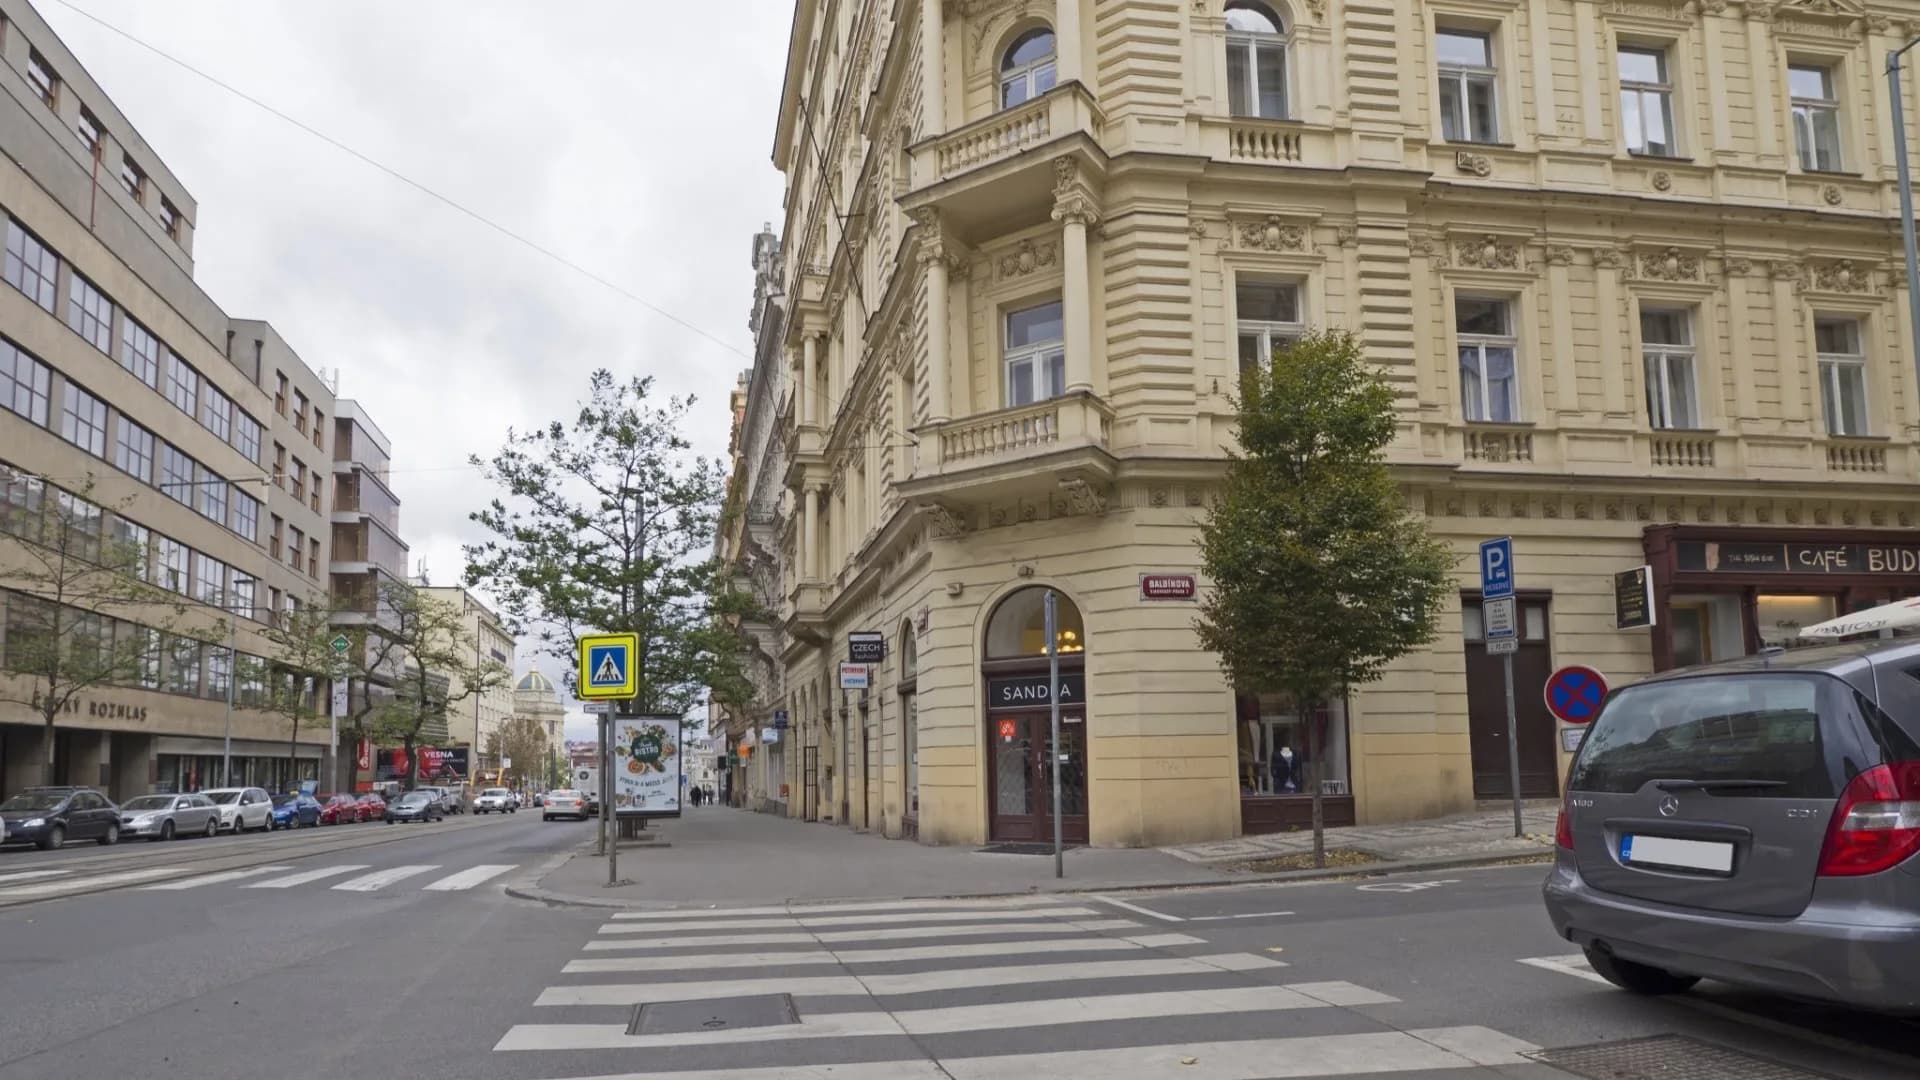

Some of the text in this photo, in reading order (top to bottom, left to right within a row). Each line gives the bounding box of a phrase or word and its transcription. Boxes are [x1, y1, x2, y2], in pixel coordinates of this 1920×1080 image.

[1486, 547, 1504, 581] P
[1799, 546, 1848, 573] CAFÉ
[1149, 578, 1190, 588] BALBÍNOVA
[852, 644, 880, 652] CZECH
[1003, 683, 1071, 701] SANDA
[89, 701, 147, 722] ROZHLAS
[424, 751, 454, 759] VESNA
